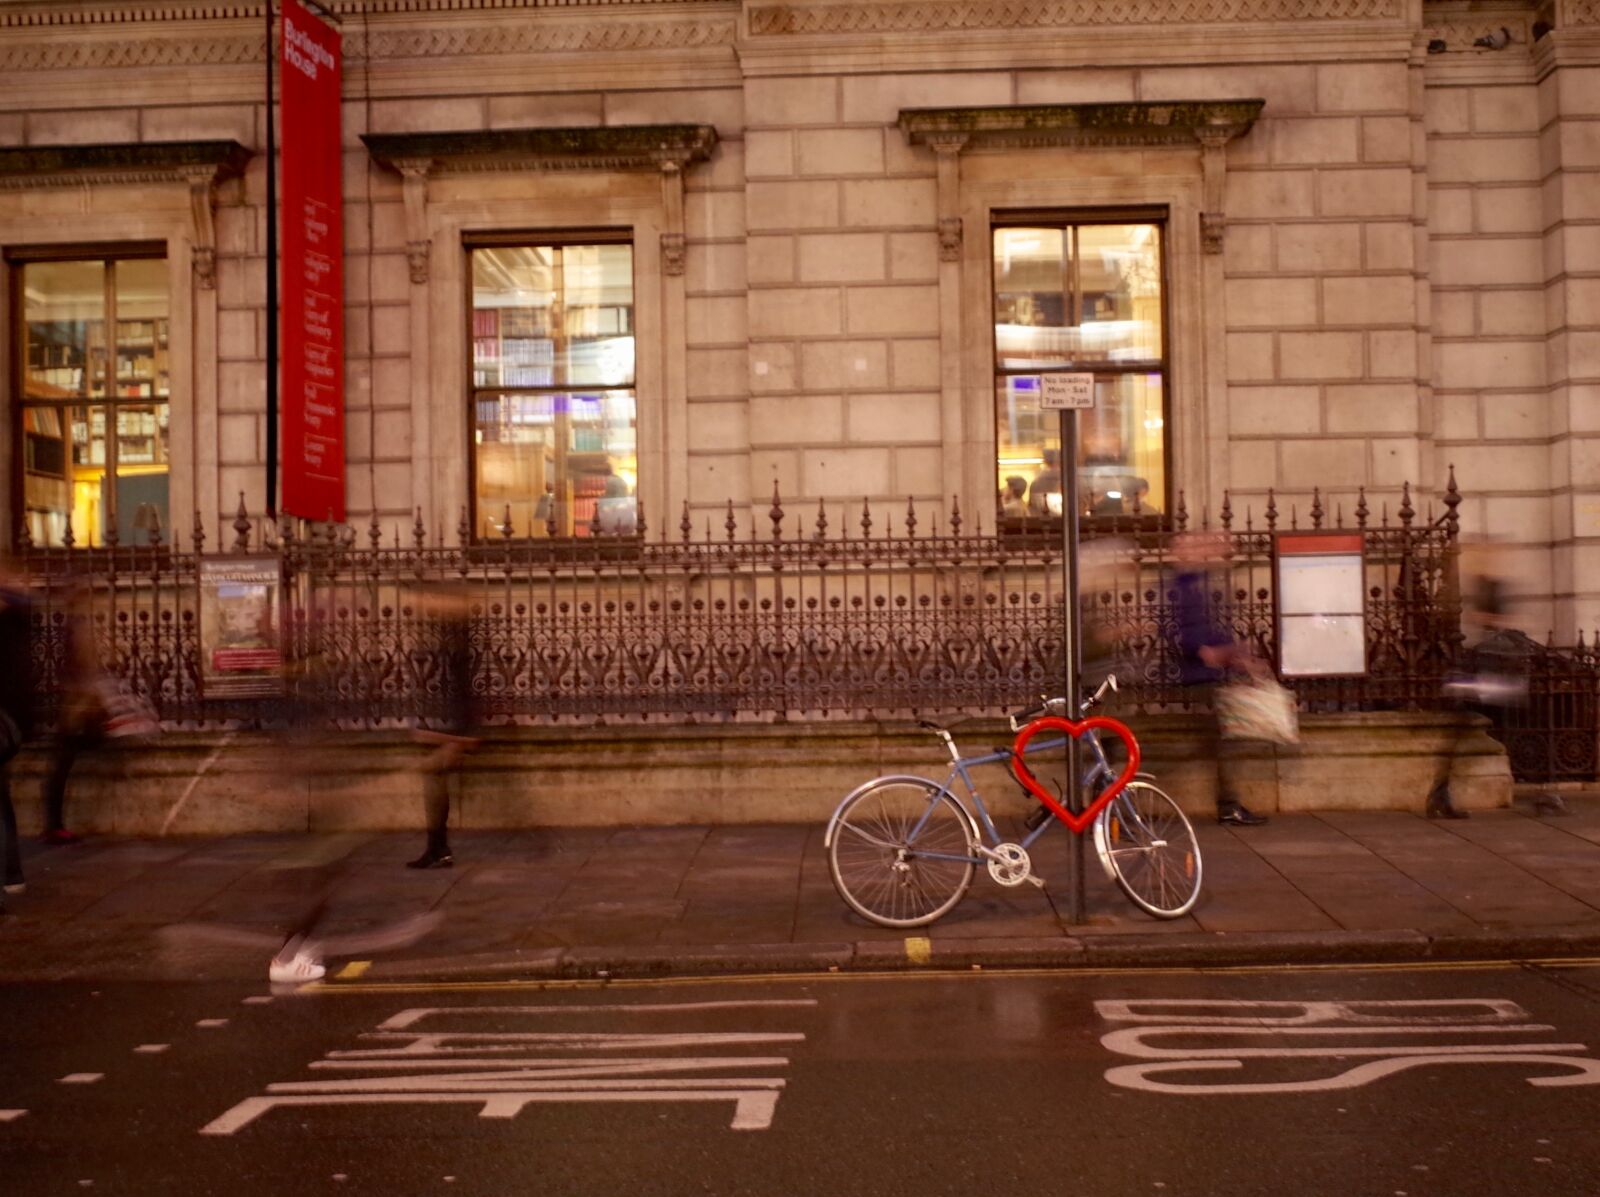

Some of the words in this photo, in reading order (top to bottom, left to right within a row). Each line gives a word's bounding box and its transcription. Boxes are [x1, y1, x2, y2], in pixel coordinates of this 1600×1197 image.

[284, 17, 335, 71] Burlington
[284, 40, 317, 80] House
[1043, 376, 1057, 384] No
